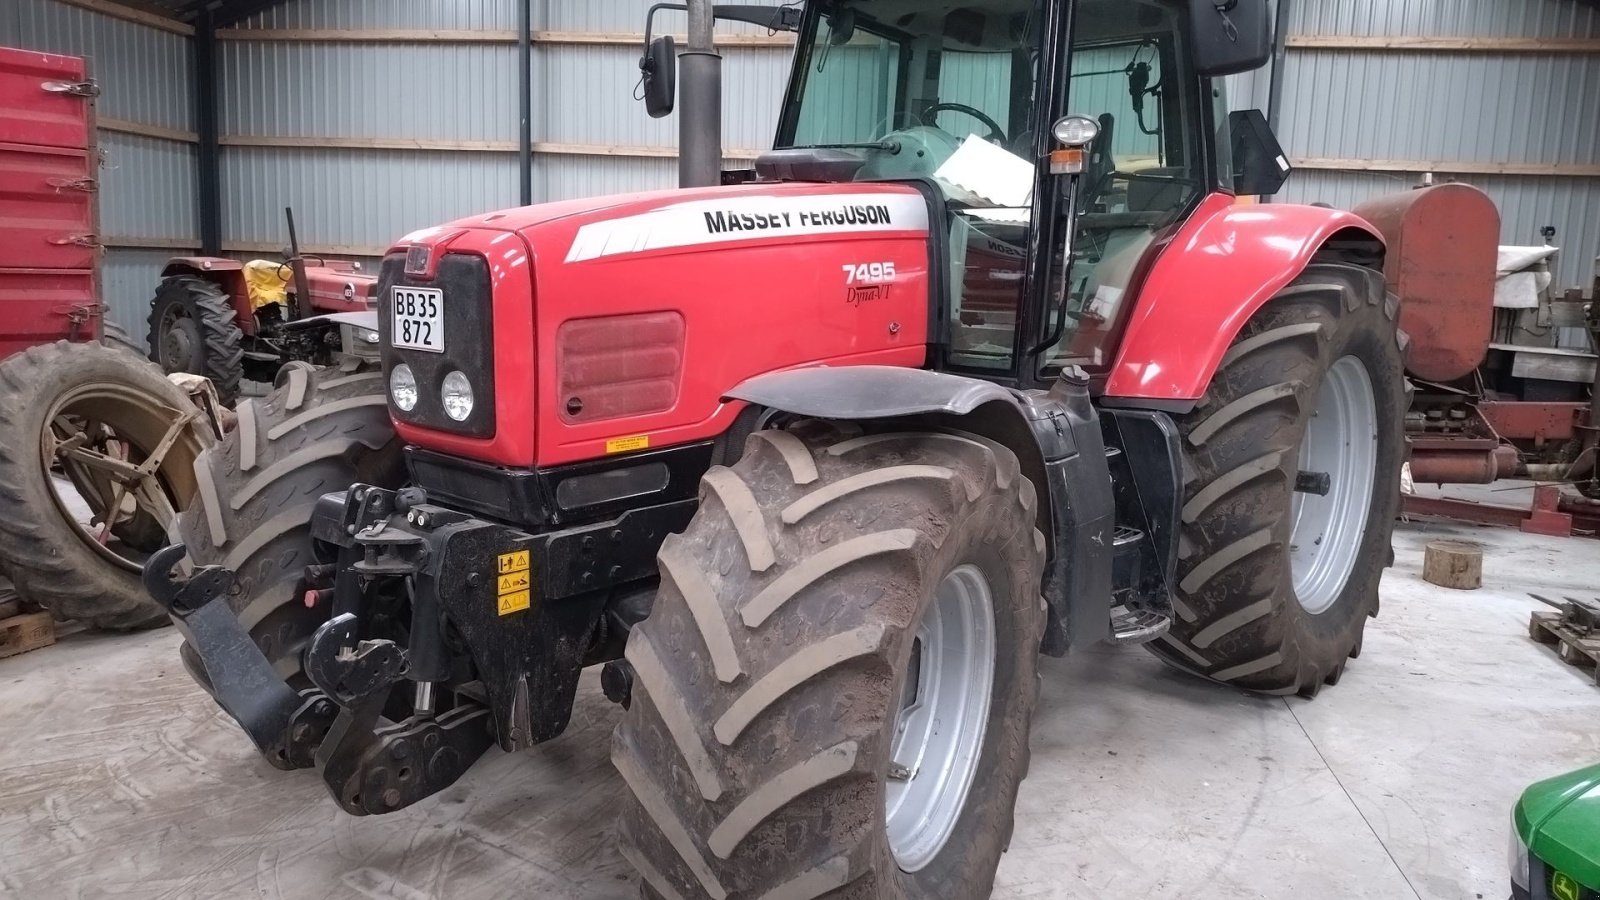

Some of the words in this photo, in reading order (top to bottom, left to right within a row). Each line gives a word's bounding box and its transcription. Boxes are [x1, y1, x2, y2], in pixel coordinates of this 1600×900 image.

[704, 210, 790, 234] MASSEY
[799, 205, 892, 227] FERGUSON
[842, 262, 896, 285] 7495
[396, 292, 437, 318] BB35
[846, 284, 893, 308] Dyna-VT
[403, 319, 432, 346] 872
